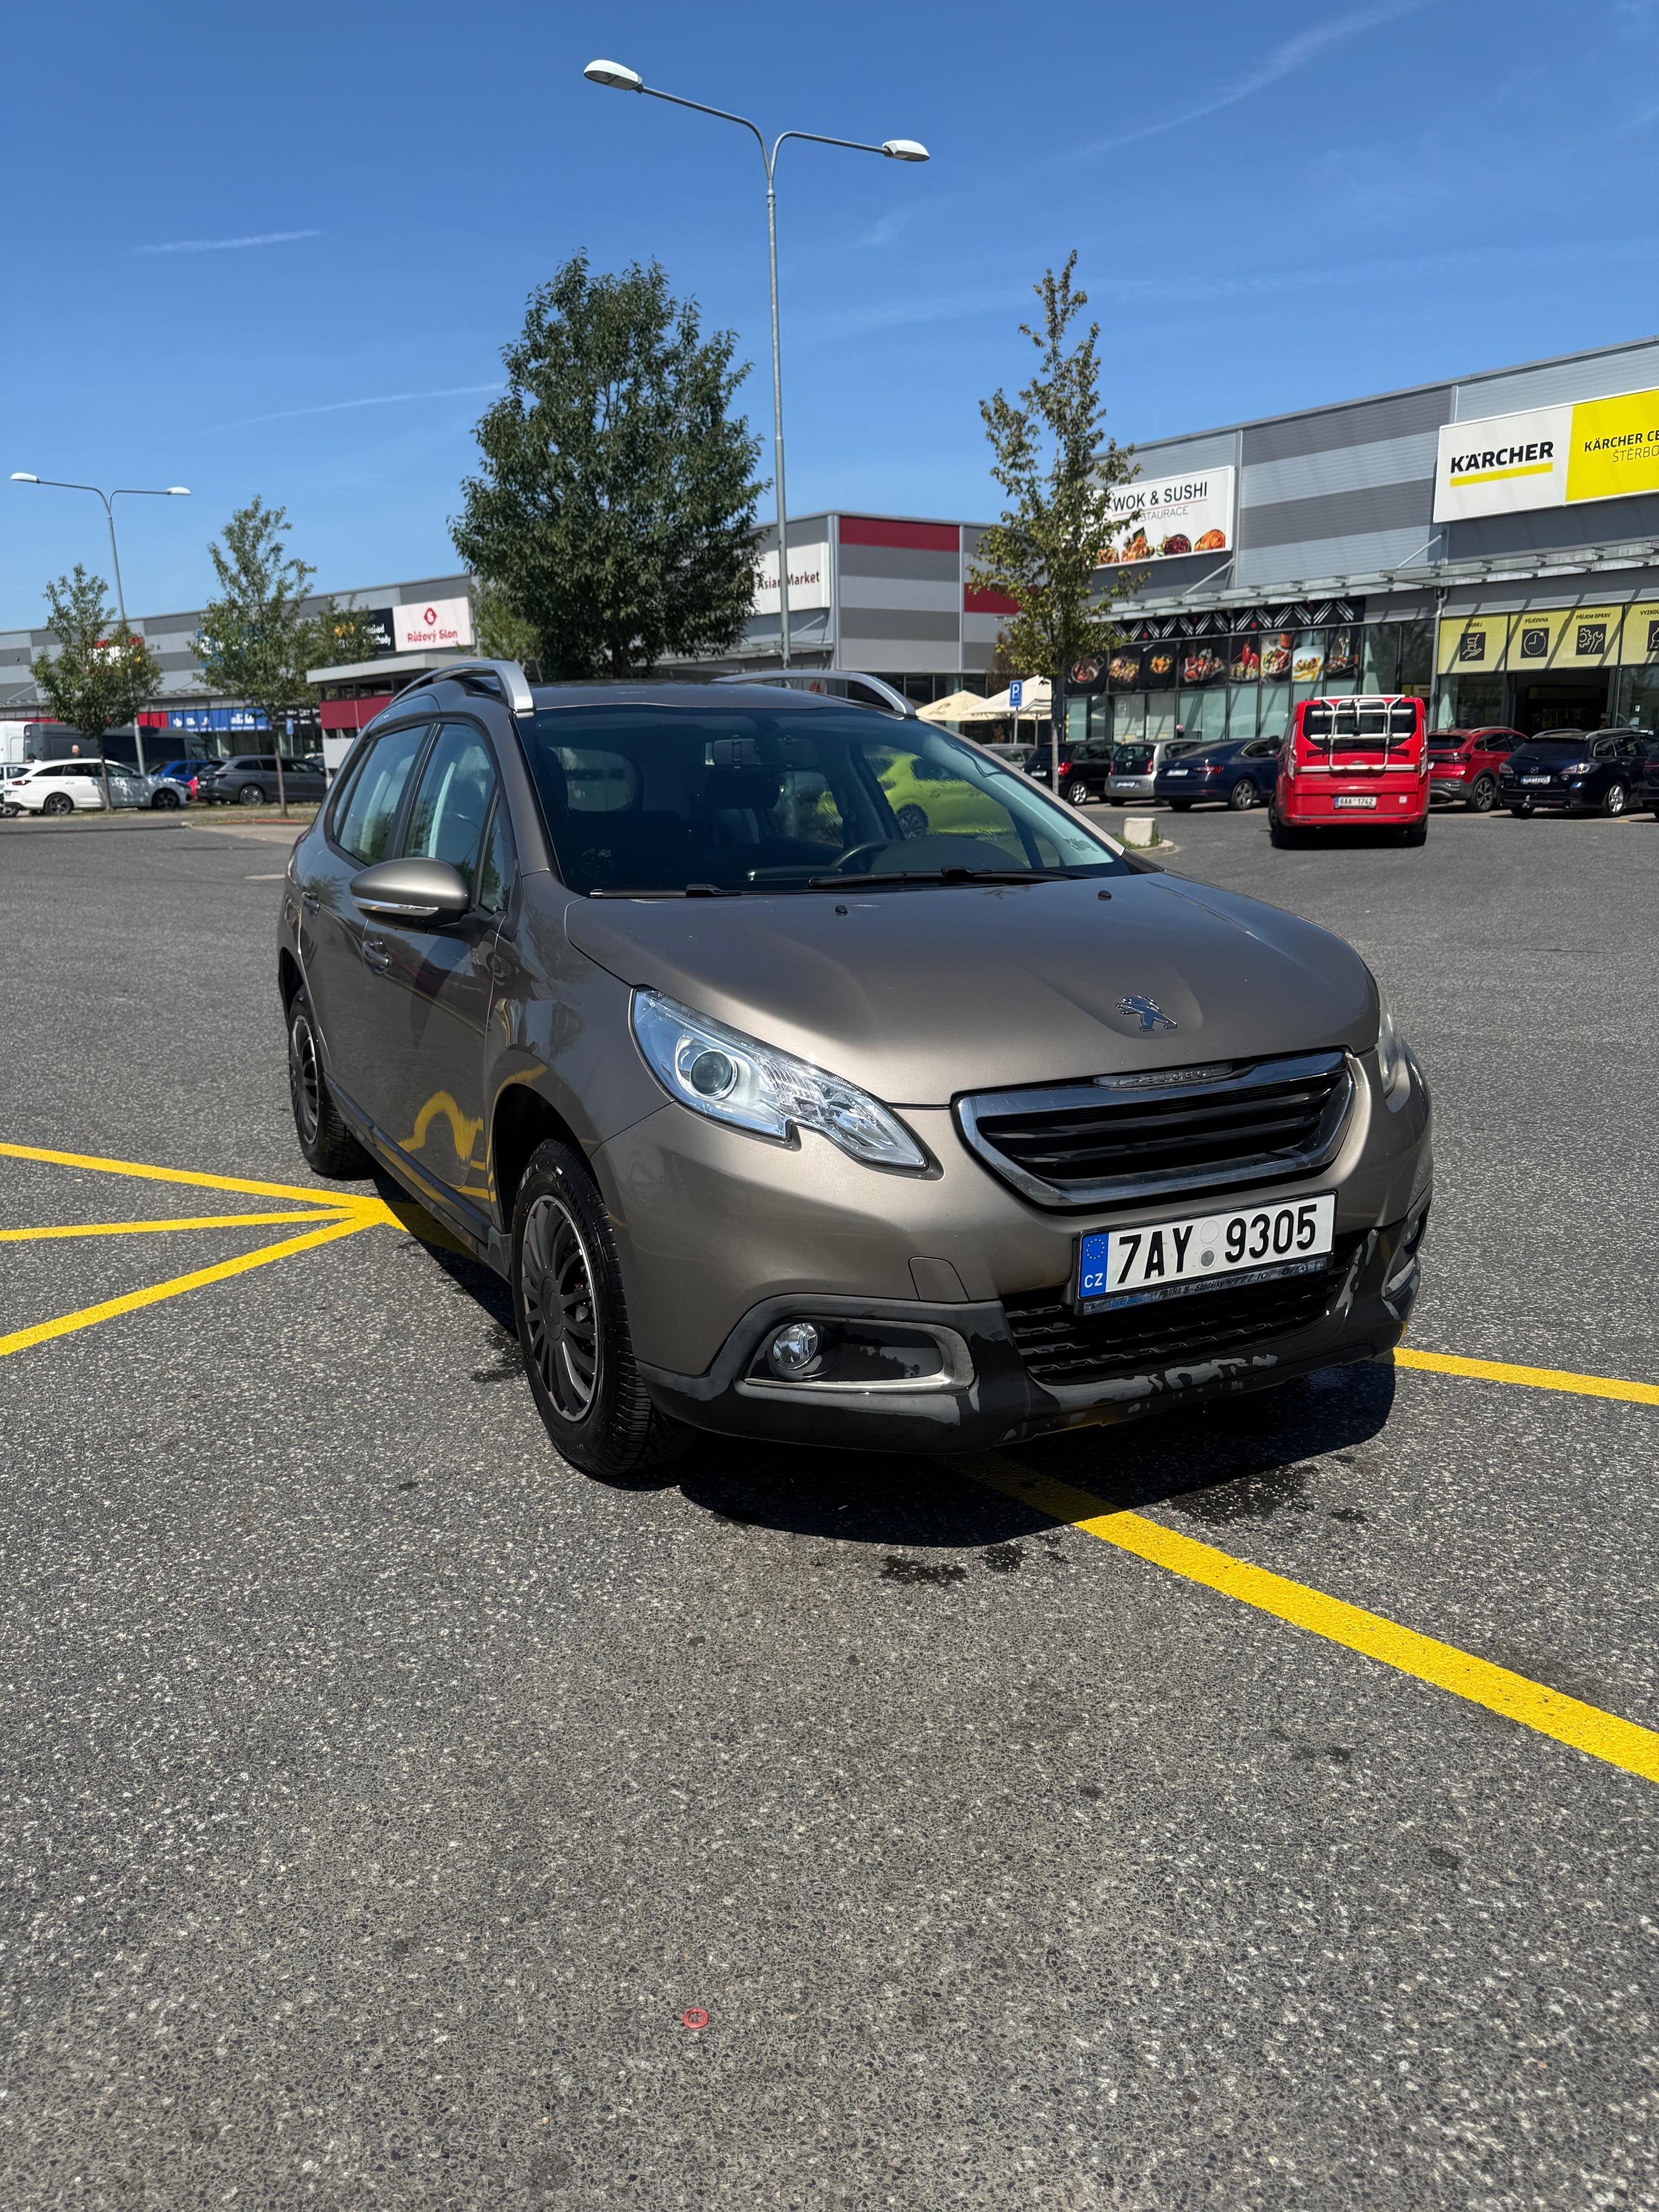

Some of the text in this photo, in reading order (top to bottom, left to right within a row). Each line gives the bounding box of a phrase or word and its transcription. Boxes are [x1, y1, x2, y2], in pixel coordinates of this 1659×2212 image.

[1584, 433, 1643, 453] KÄRCHER
[1450, 441, 1554, 474] KÄRCHER
[1612, 445, 1659, 463] ŠTĚRBO
[1114, 481, 1208, 512] WOK & SUSHI
[1132, 505, 1189, 523] STAURACE
[786, 571, 820, 586] Market
[407, 629, 458, 643] Růžový Slon
[1012, 684, 1020, 700] P
[1133, 1068, 1216, 1084] PEUGEOT
[1116, 1204, 1317, 1285] 7AY 9305
[1084, 1272, 1103, 1289] CZ
[1159, 1287, 1182, 1299] PRAHA
